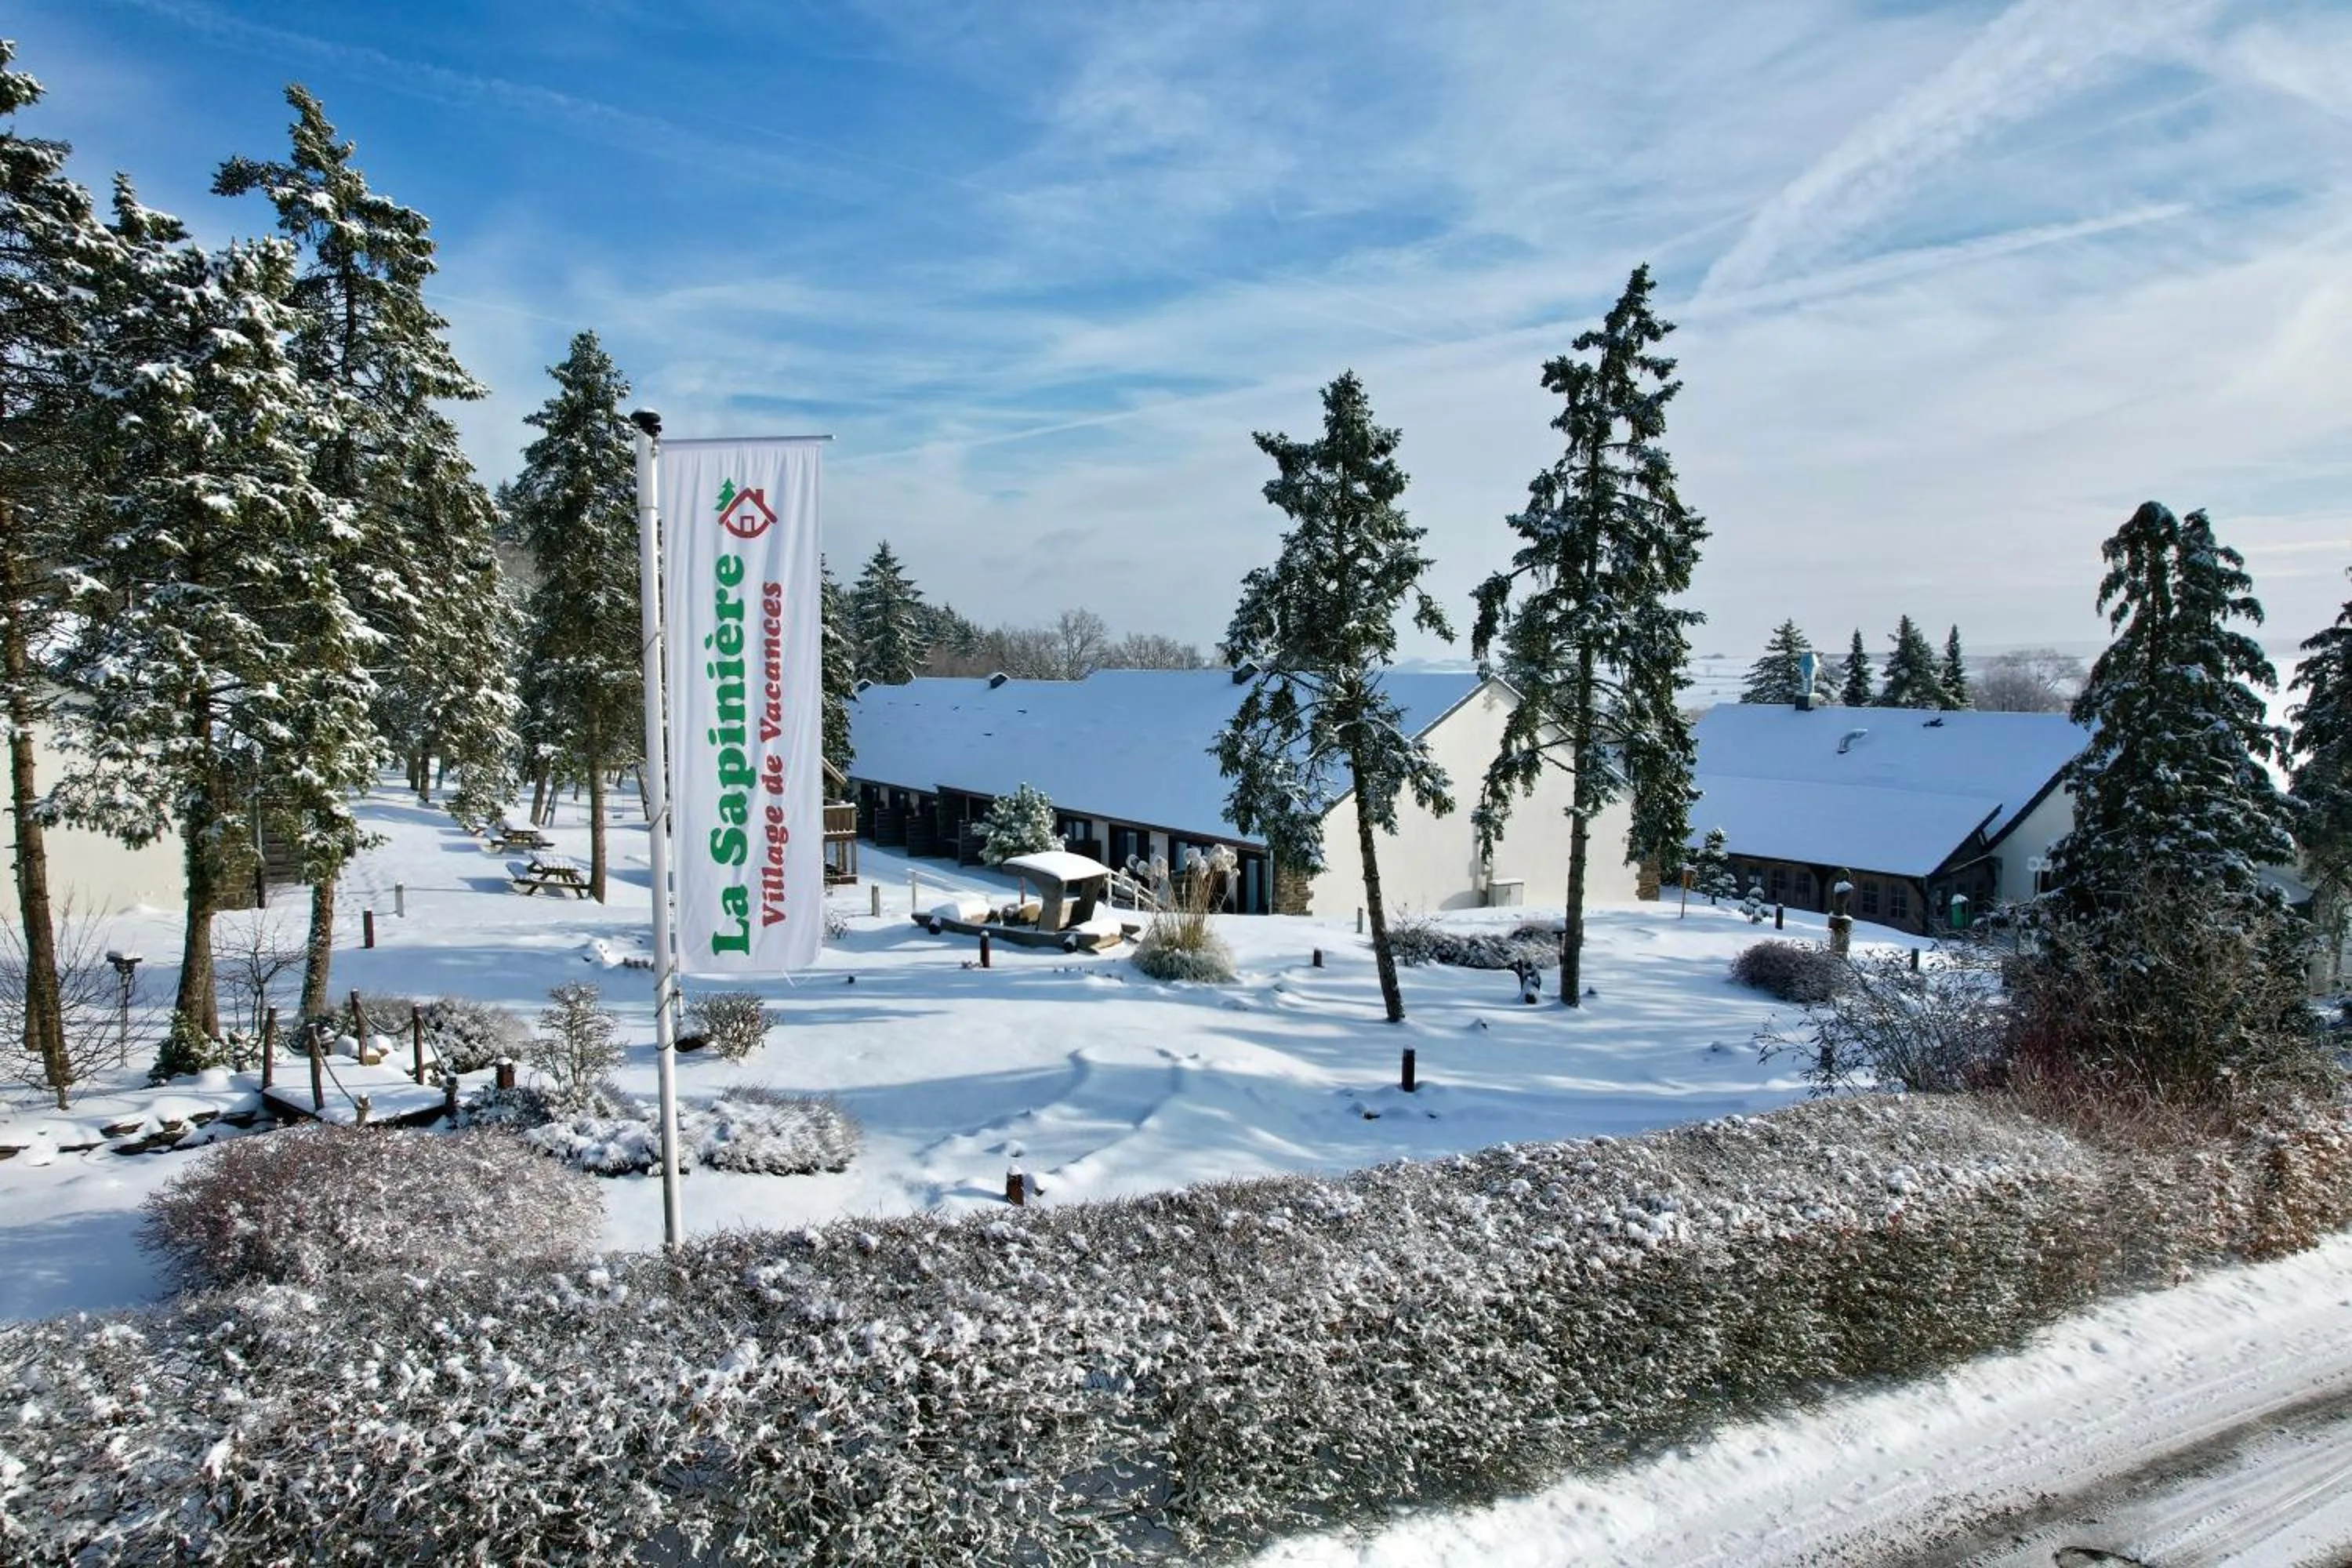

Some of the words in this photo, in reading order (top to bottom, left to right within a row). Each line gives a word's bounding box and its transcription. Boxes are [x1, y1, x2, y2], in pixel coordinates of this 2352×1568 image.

[705, 554, 756, 867] Sapinière
[760, 581, 782, 743] Vacances
[762, 755, 782, 795] de
[712, 885, 750, 956] La
[762, 806, 787, 927] Village
